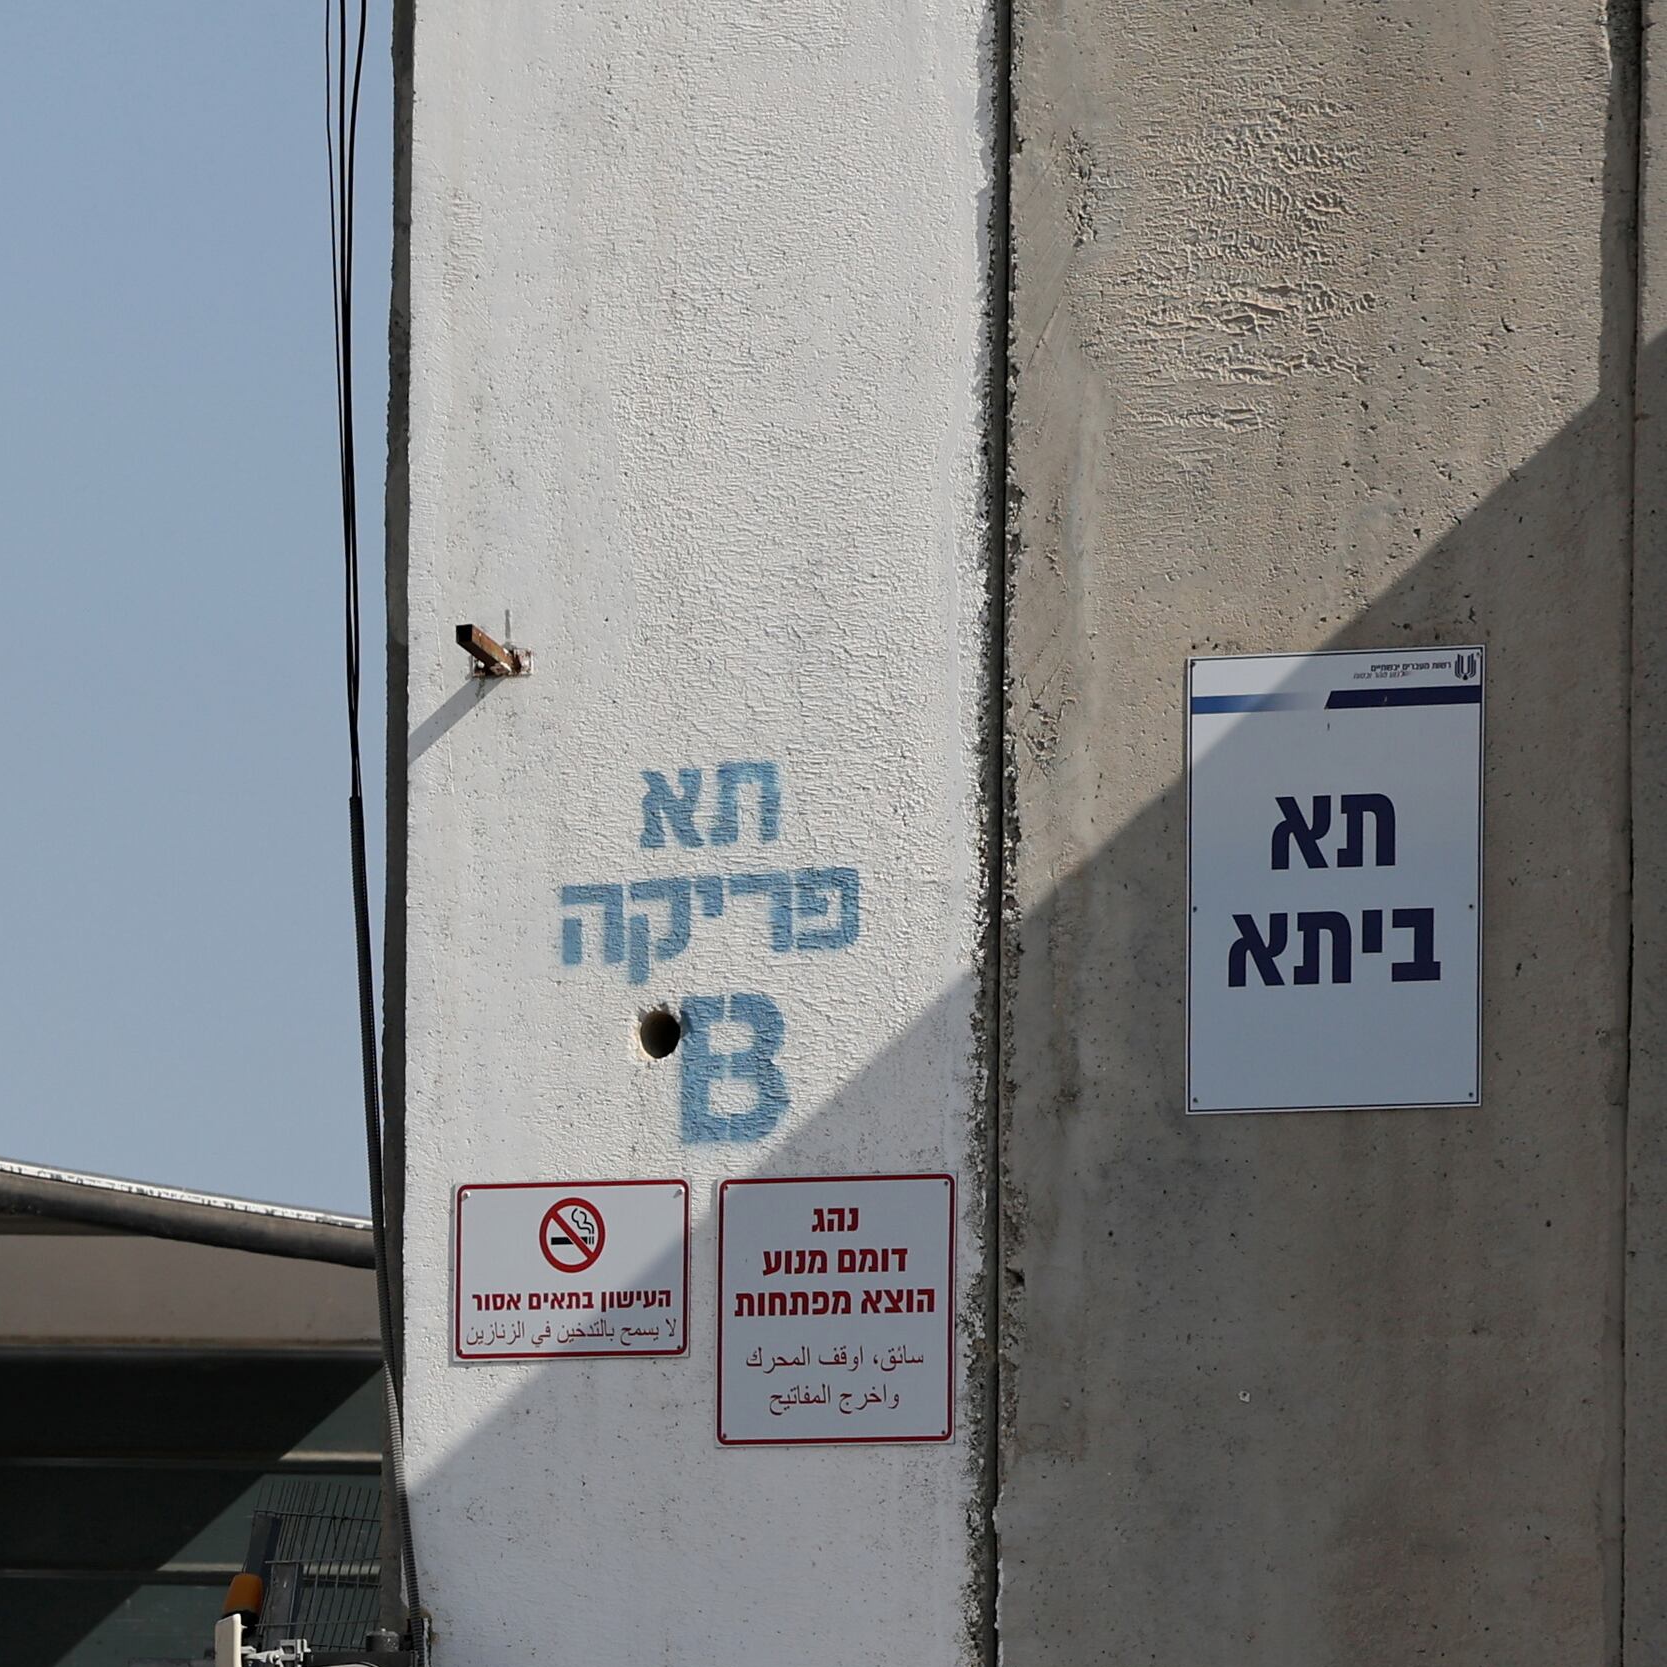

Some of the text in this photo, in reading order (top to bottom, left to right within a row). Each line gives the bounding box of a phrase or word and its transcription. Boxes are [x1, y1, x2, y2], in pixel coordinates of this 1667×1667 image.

[638, 759, 785, 850] תא
[1270, 793, 1397, 870] תא
[560, 865, 862, 987] פריקה
[1227, 907, 1442, 988] ביתא
[679, 991, 792, 1146] B
[811, 1207, 860, 1233] נהג
[762, 1247, 908, 1277] דומם מנוע
[471, 1289, 672, 1313] העישון בתאים אסור
[734, 1288, 936, 1317] הוצא מפתחות
[465, 1318, 677, 1349] لا يسمح بالتدخين في الزنازين
[745, 1345, 811, 1374] المحرك
[768, 1383, 832, 1415] المفاتيح
